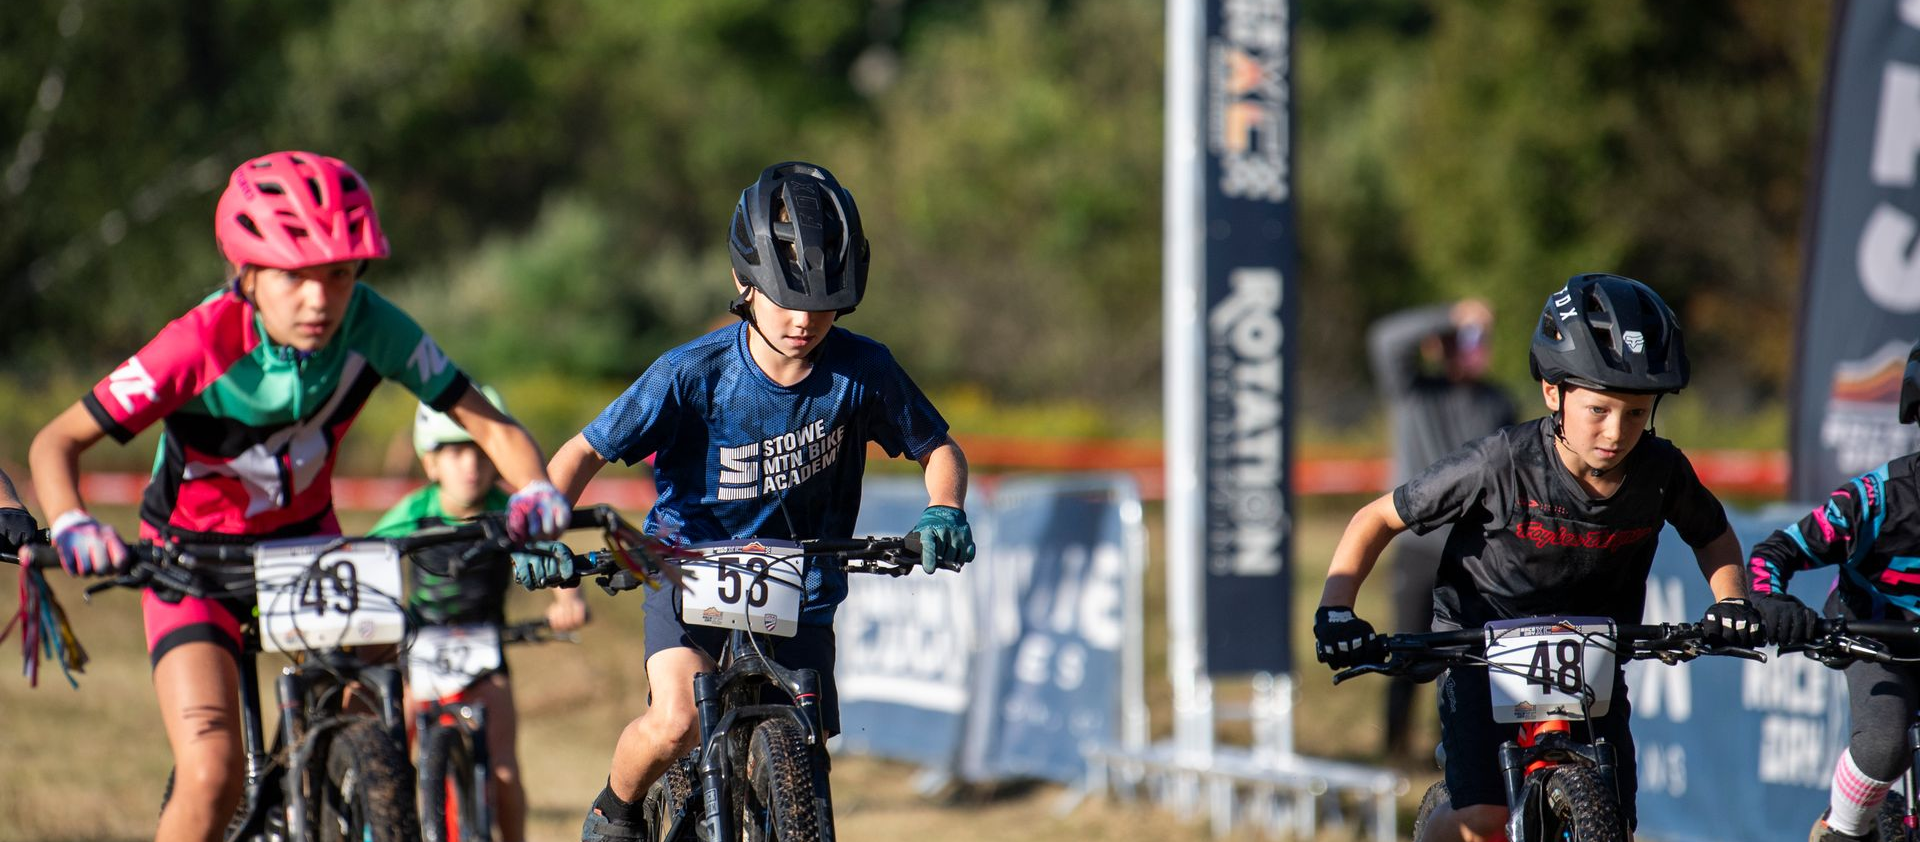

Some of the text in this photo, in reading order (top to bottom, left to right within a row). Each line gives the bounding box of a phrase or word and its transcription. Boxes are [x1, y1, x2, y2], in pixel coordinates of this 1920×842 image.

[762, 419, 826, 457] STOWE
[1209, 269, 1283, 575] ROTATION
[763, 425, 845, 475] MTN BIKE
[763, 443, 842, 495] ACADEM
[300, 560, 358, 617] 49
[718, 557, 769, 608] 53
[1526, 638, 1583, 695] 48
